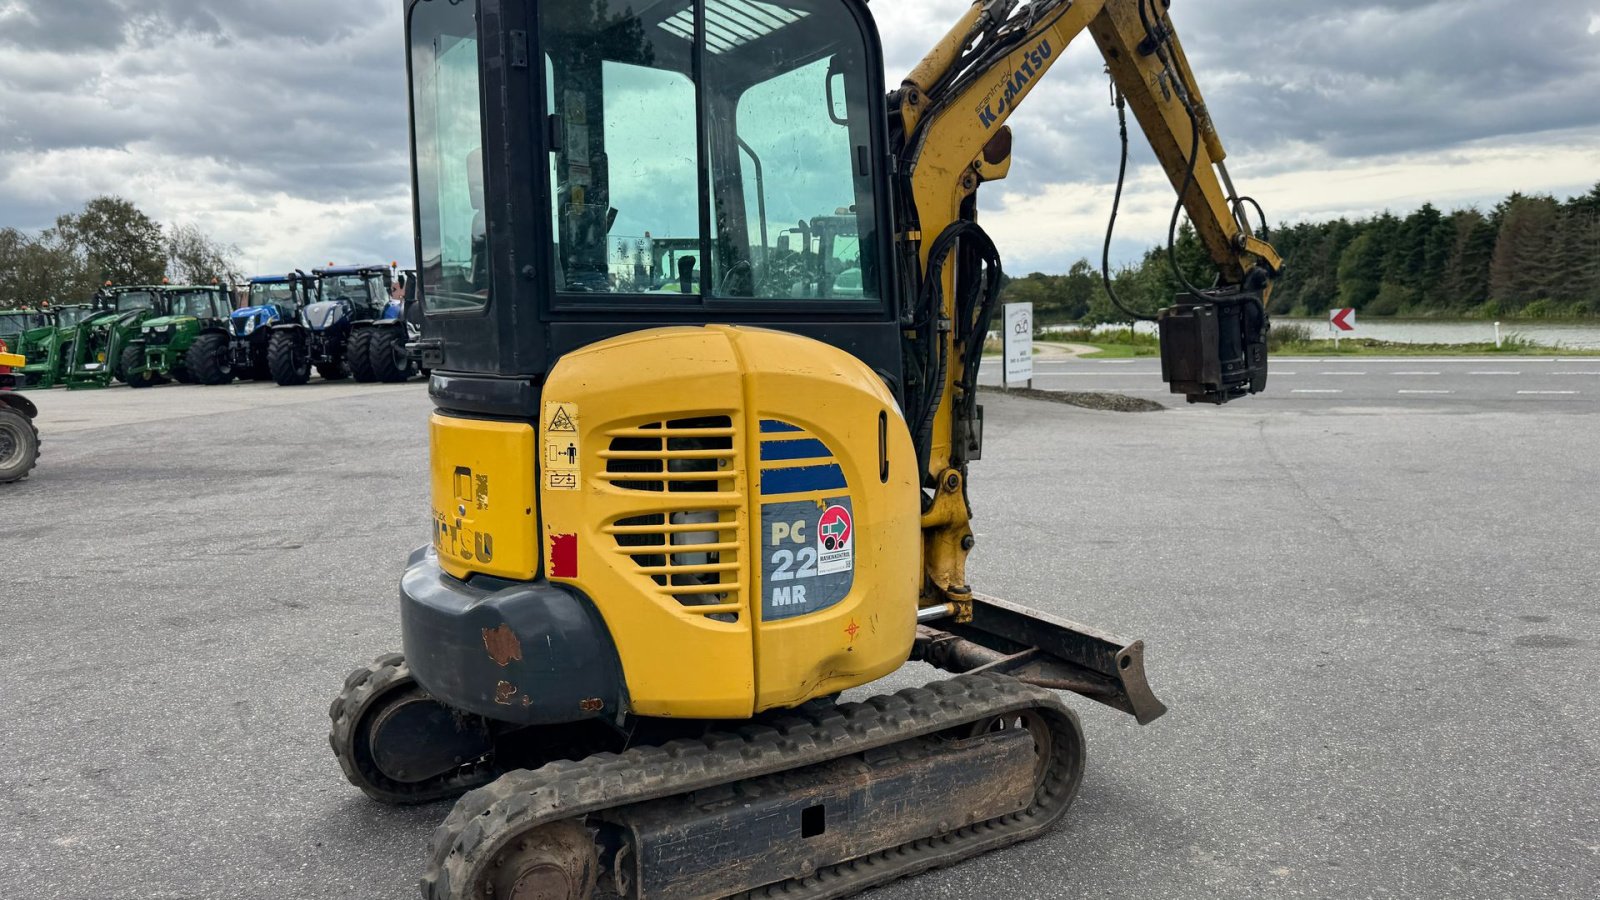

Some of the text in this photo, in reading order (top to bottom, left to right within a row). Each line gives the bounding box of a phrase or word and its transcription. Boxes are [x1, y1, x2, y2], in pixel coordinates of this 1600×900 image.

[771, 520, 806, 546] PC
[770, 546, 818, 582] 22
[771, 584, 807, 607] MR
